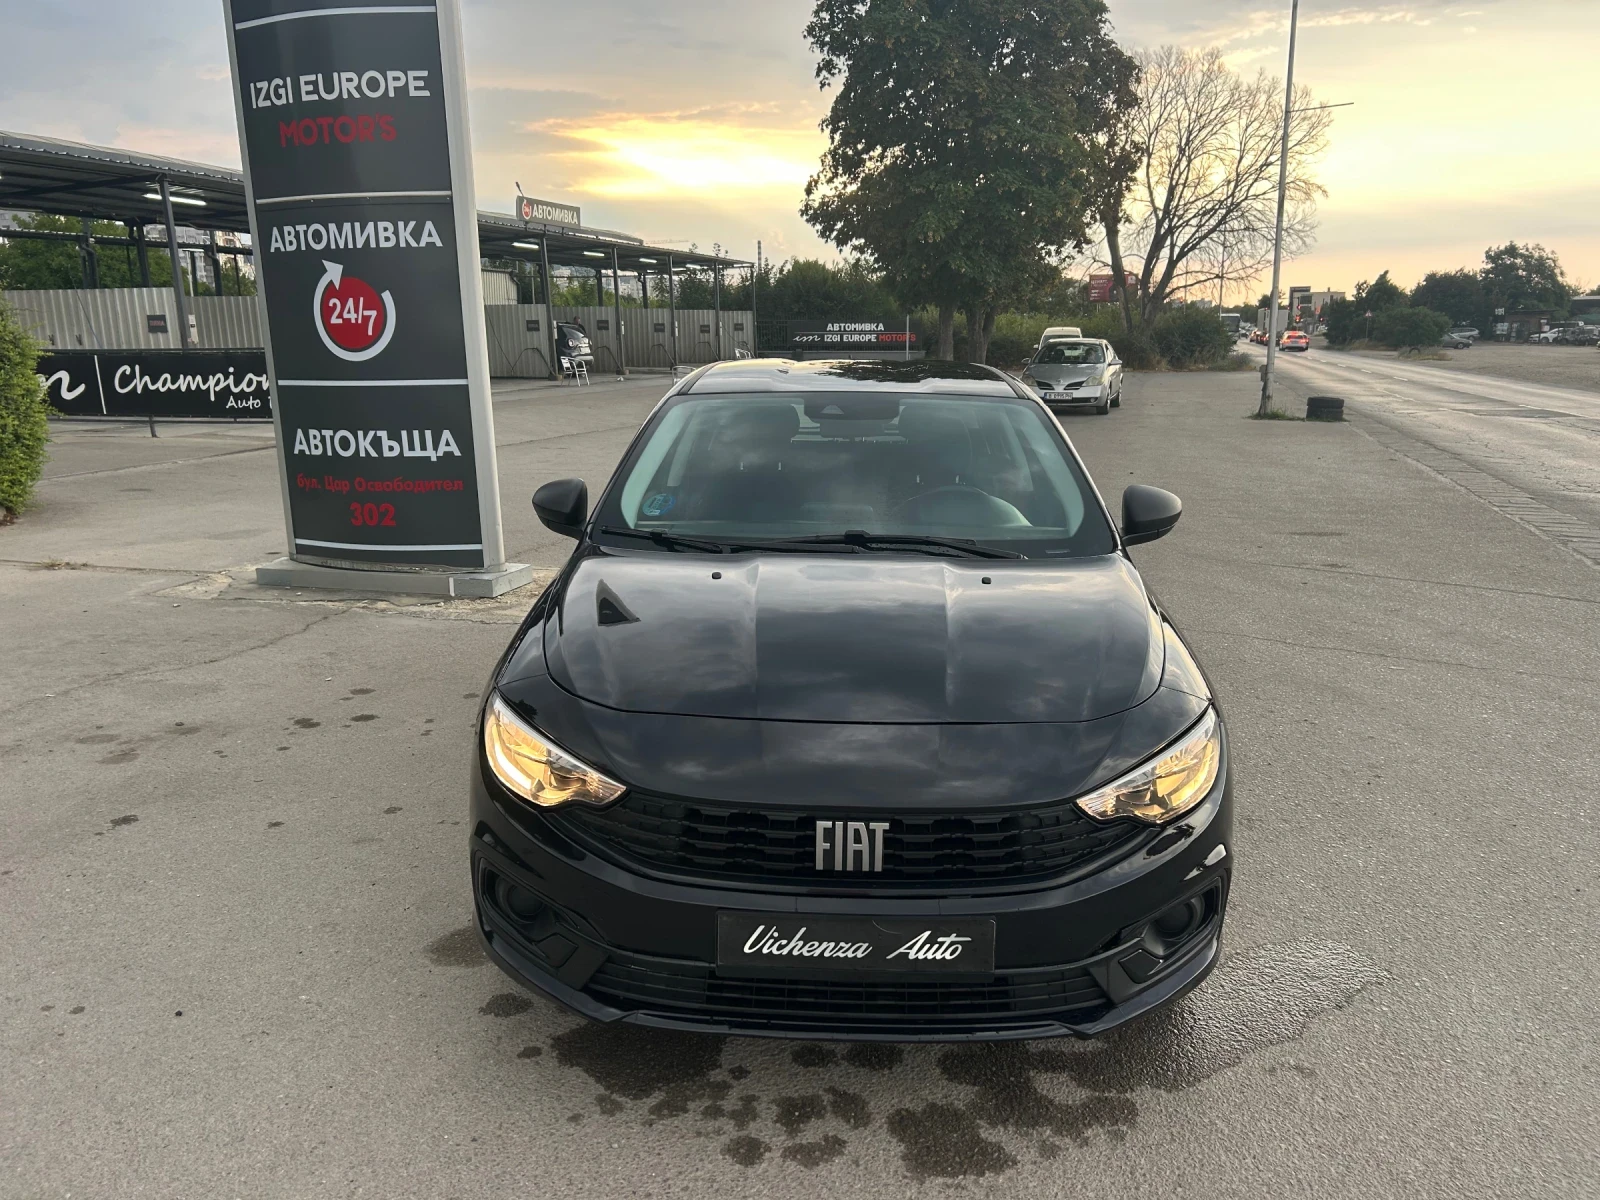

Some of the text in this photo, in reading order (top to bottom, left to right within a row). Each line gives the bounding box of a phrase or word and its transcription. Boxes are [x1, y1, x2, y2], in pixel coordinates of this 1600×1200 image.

[249, 70, 431, 109] IZGI EUROPE
[278, 114, 398, 148] MOTOR'S
[532, 203, 579, 225] АВТОМИВКА
[269, 220, 443, 253] АВТОМИВКА
[328, 296, 378, 336] 24/7
[826, 322, 885, 331] АВТОМИВКА
[824, 334, 841, 342] IZGI
[843, 334, 877, 342] EUROPE
[225, 395, 262, 410] Auto
[293, 428, 462, 461] АВТОКЪЩА
[296, 473, 464, 494] бул. Цар Освободител
[349, 502, 397, 527] 302
[815, 820, 890, 872] FIAT
[743, 924, 972, 960] Vichenza Auto
